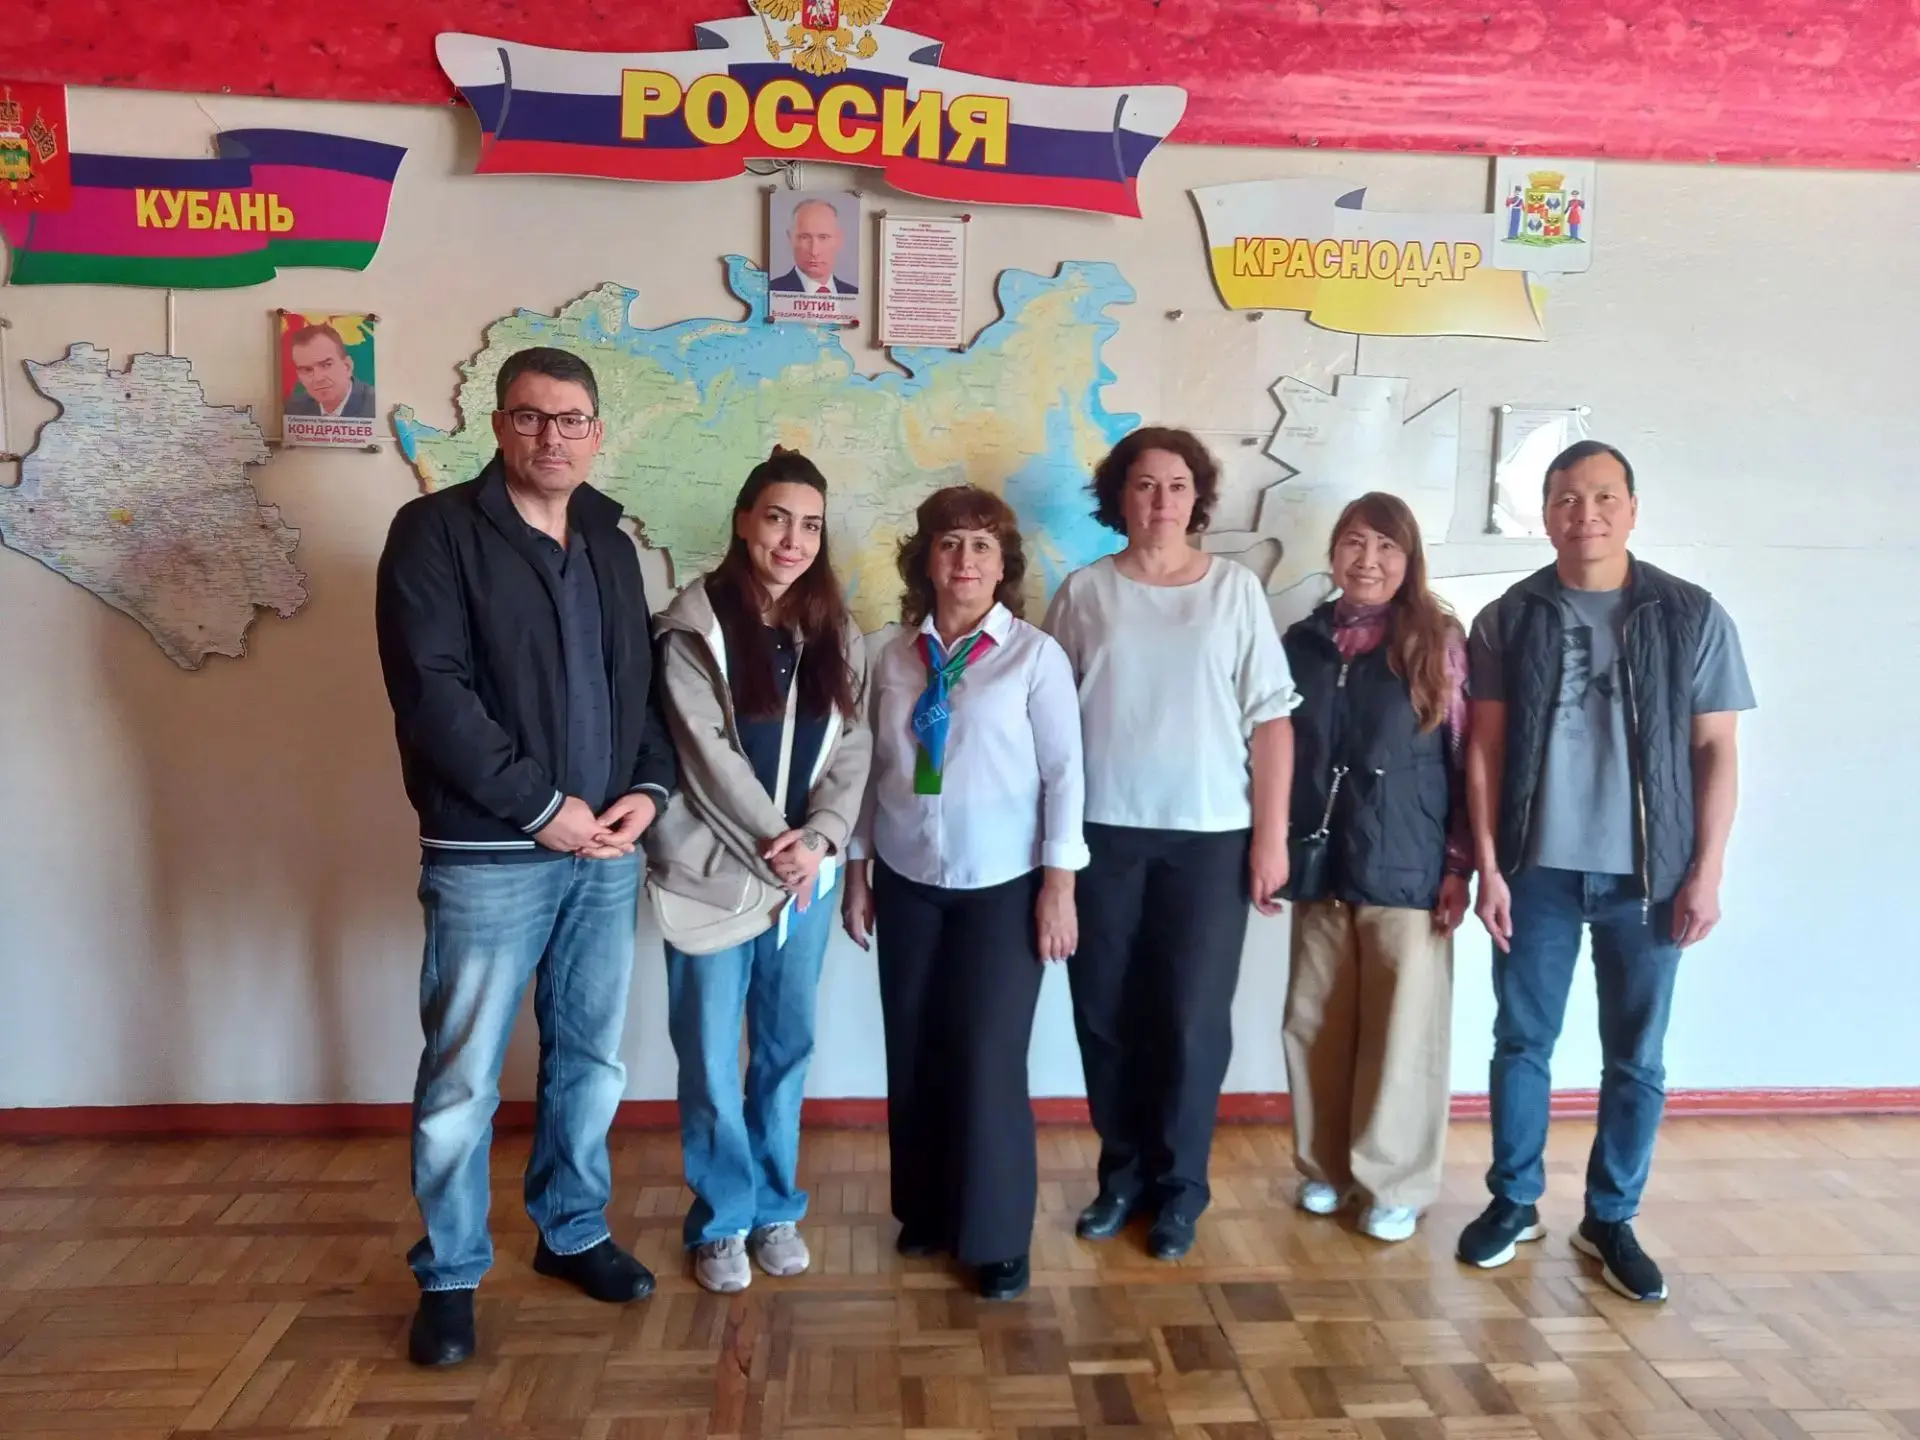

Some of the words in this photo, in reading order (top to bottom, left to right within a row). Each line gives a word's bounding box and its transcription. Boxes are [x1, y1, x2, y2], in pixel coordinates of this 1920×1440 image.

[619, 68, 1010, 167] РОССИЯ
[135, 188, 295, 232] КУБАНЬ
[1233, 237, 1482, 287] КРАСНОДАР
[793, 300, 836, 312] ПУТИН
[288, 423, 373, 437] КОНДРАТЬЕВ
